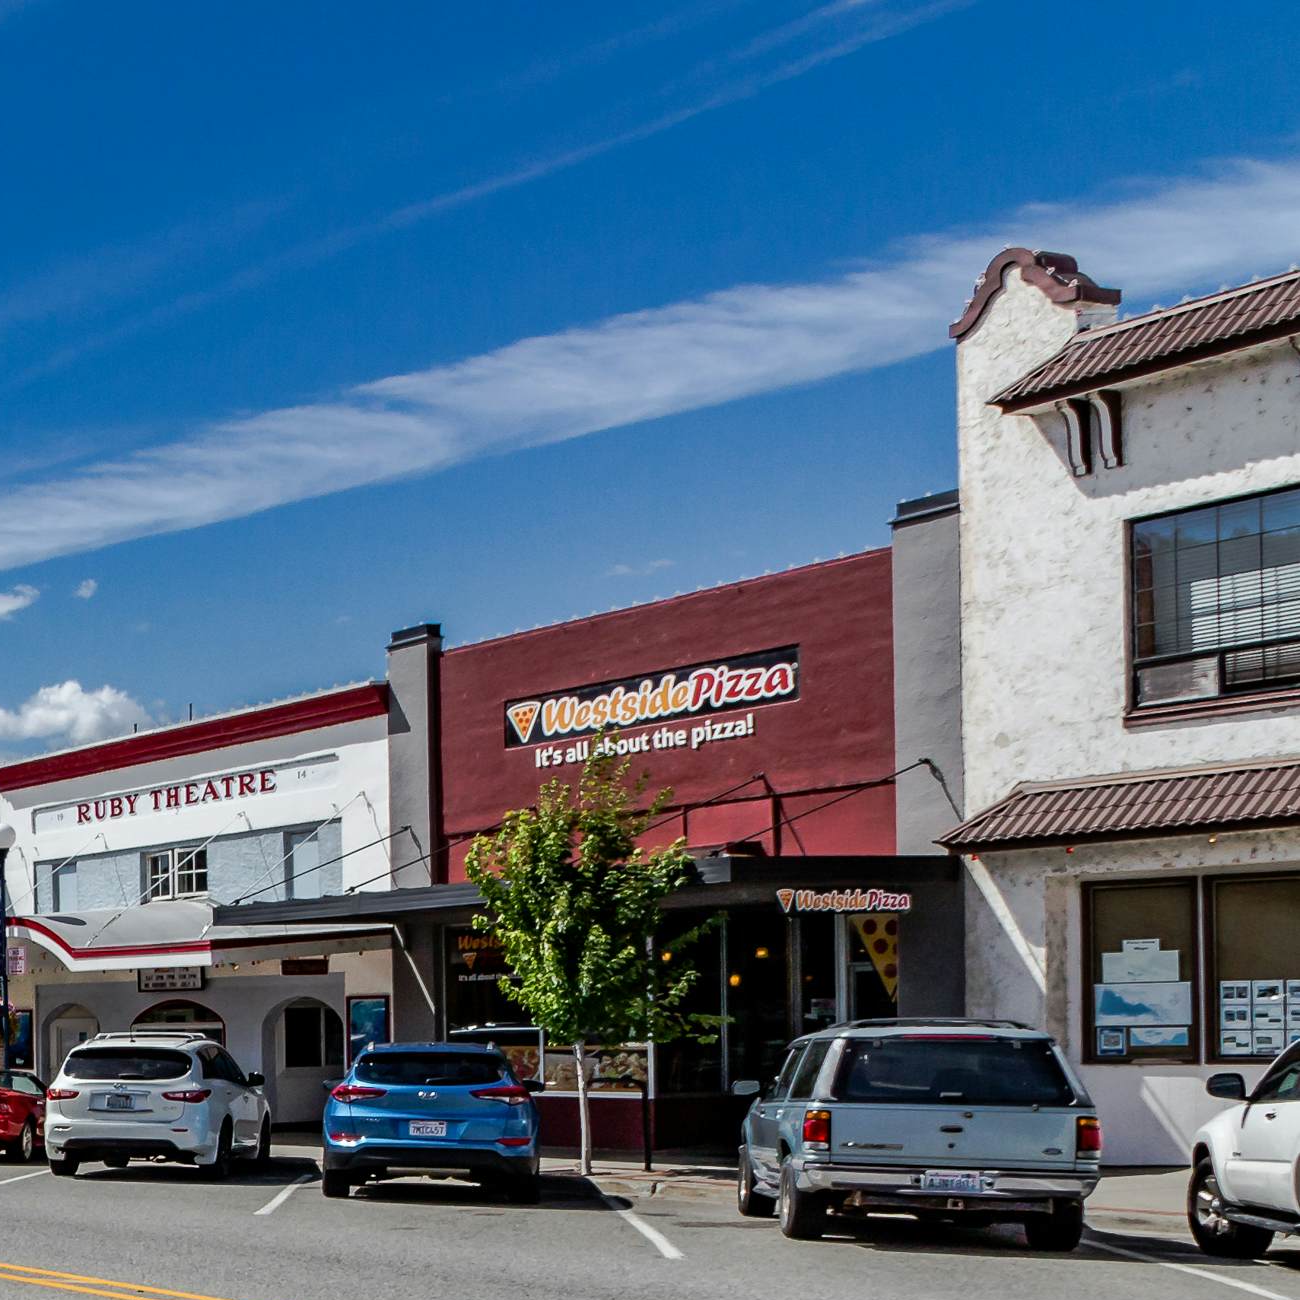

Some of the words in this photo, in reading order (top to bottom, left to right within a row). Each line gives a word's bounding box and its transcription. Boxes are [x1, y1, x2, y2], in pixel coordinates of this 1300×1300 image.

[541, 663, 794, 736] WestsidePizza
[535, 748, 563, 768] It's
[565, 741, 590, 763] all
[592, 735, 650, 759] about
[652, 725, 688, 748] the
[691, 713, 755, 749] pizza!
[77, 794, 139, 824] RUBY
[150, 769, 277, 811] THEATRE
[297, 770, 307, 780] 14
